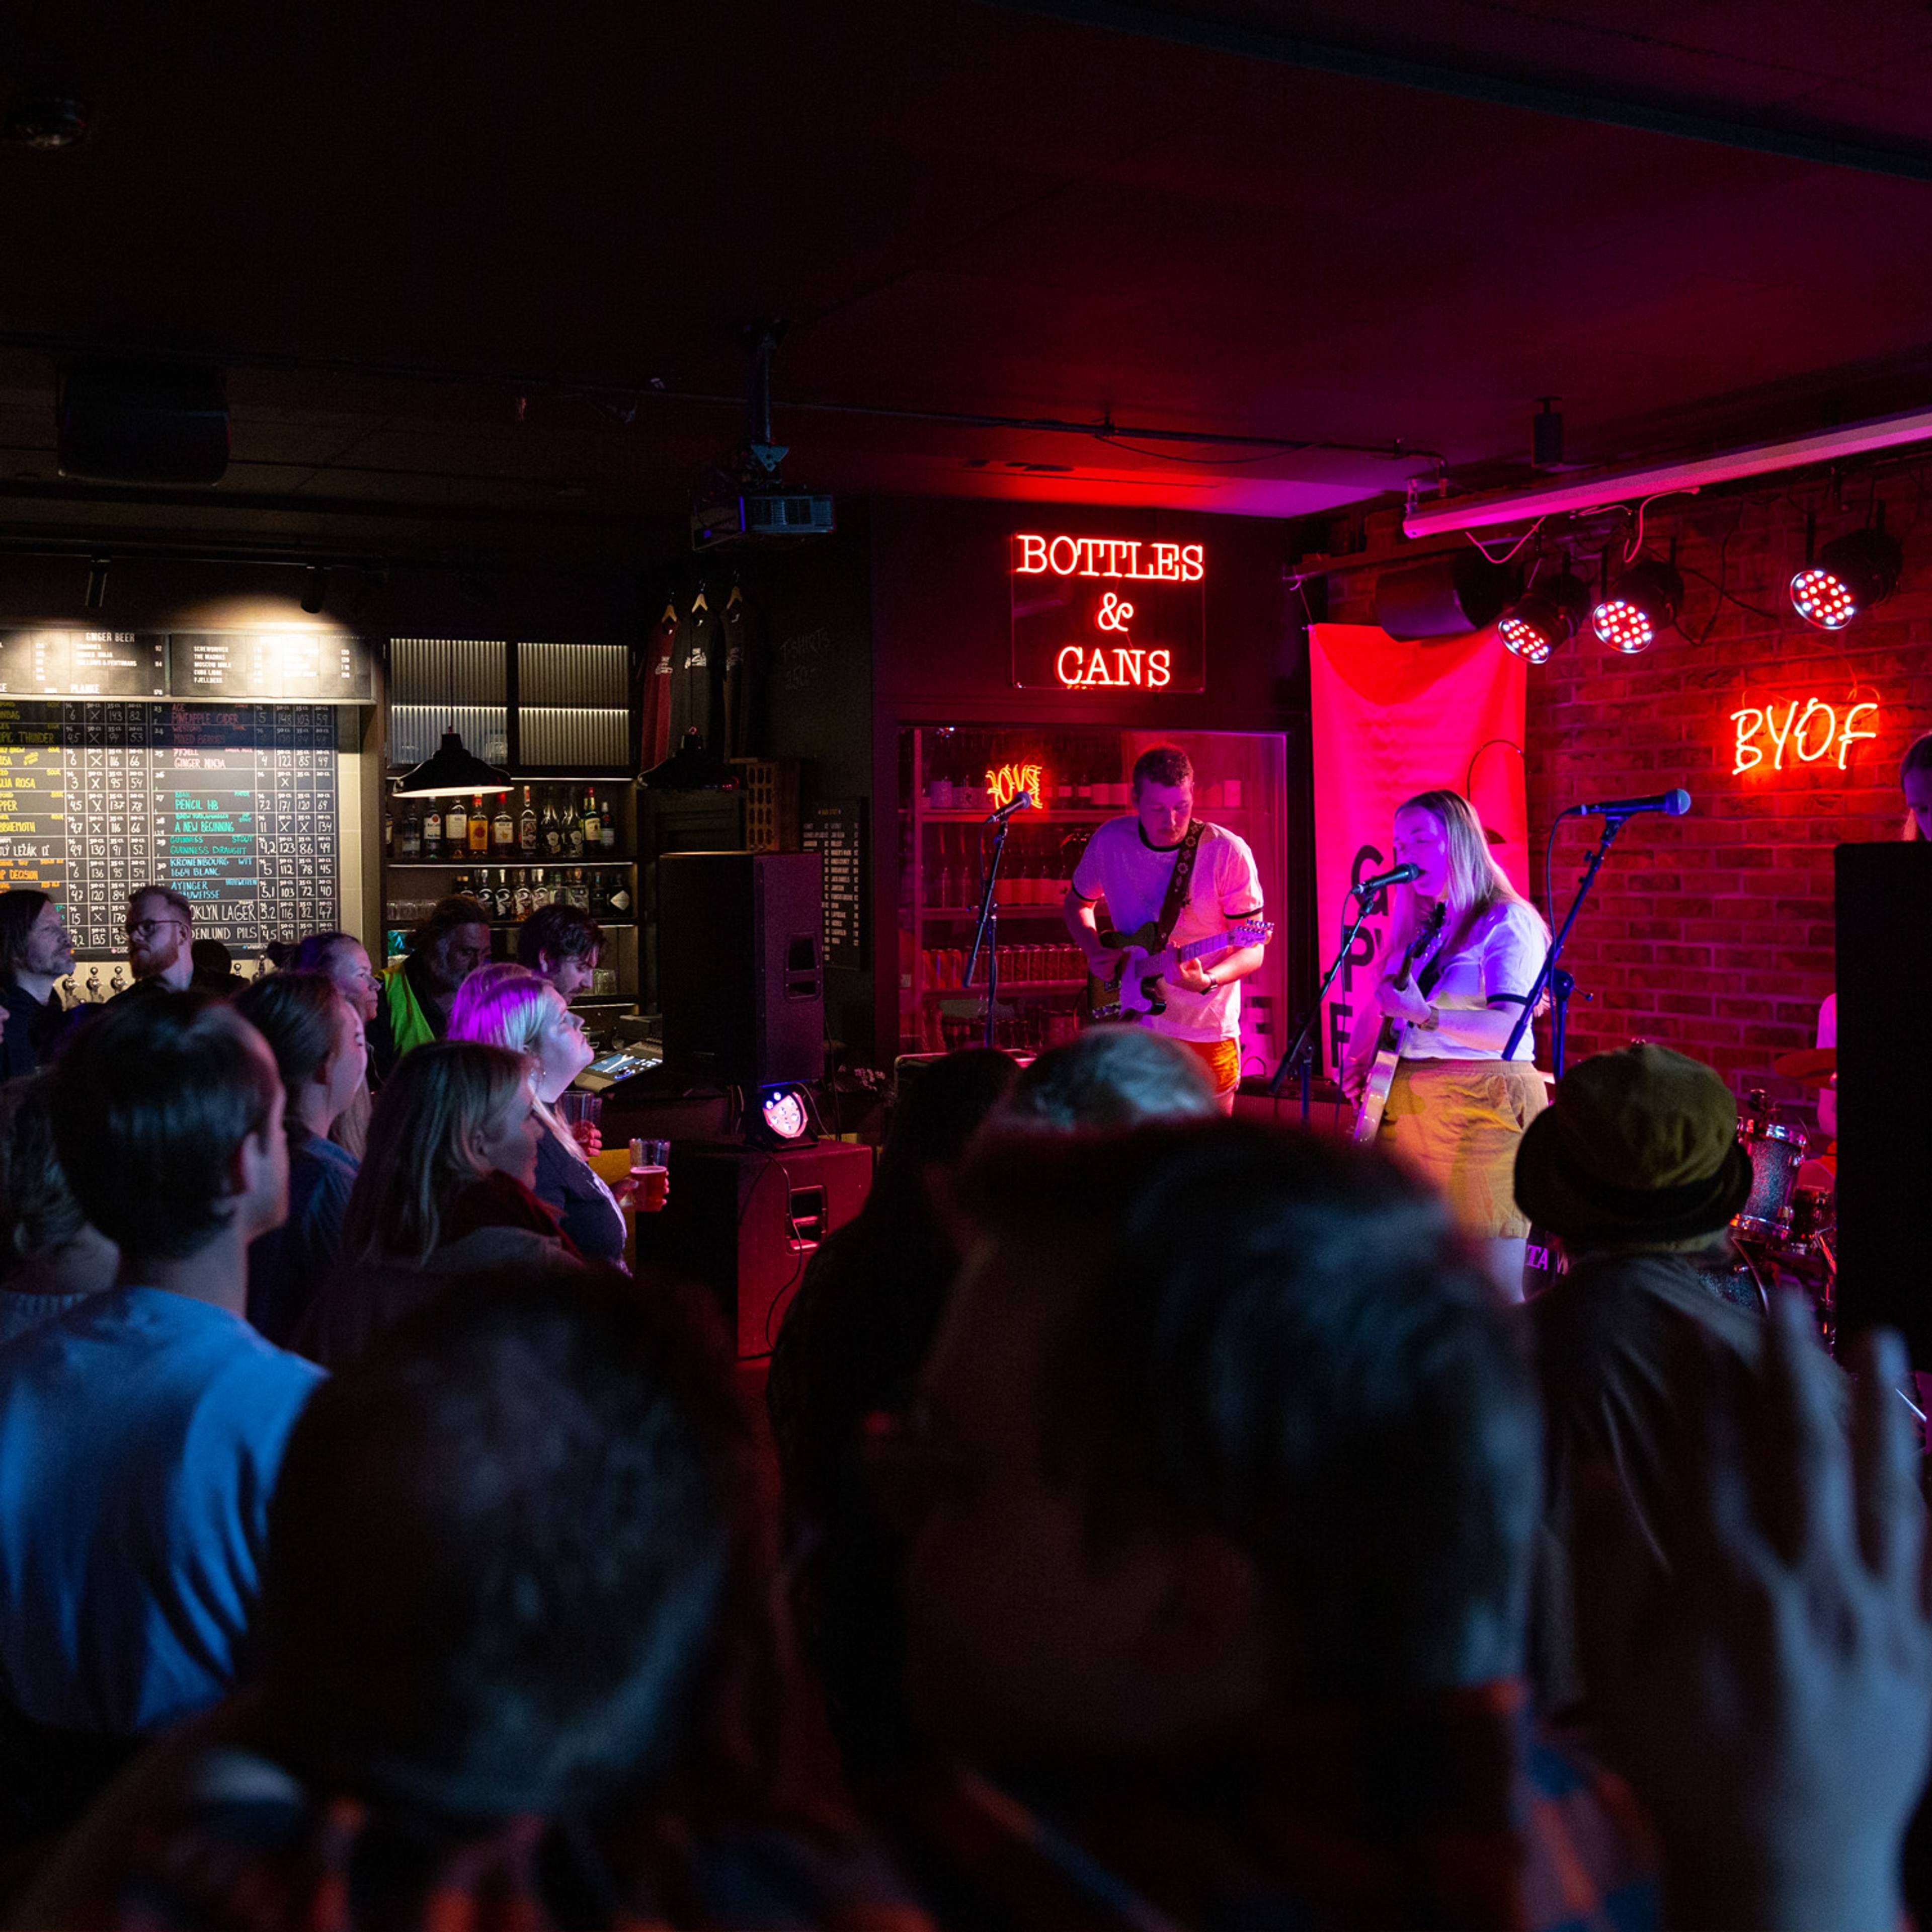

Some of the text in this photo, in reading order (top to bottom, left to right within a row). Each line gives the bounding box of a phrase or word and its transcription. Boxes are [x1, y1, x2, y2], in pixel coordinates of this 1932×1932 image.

[1014, 534, 1204, 582] BOTTLES
[1097, 592, 1135, 632] &
[86, 632, 135, 642] GINGER BEER
[1057, 646, 1171, 688] CANS
[1730, 697, 1878, 775] BYOF
[279, 755, 292, 767] 122
[175, 799, 219, 811] PENCIL HB
[175, 822, 182, 833] A
[183, 821, 199, 833] NEW
[91, 845, 105, 856] 130
[281, 887, 295, 898] 103
[301, 886, 315, 897] 72
[320, 886, 333, 897] 40
[190, 905, 257, 921] OKLYN LAGER
[281, 908, 293, 919] 116
[236, 926, 257, 939] PILS
